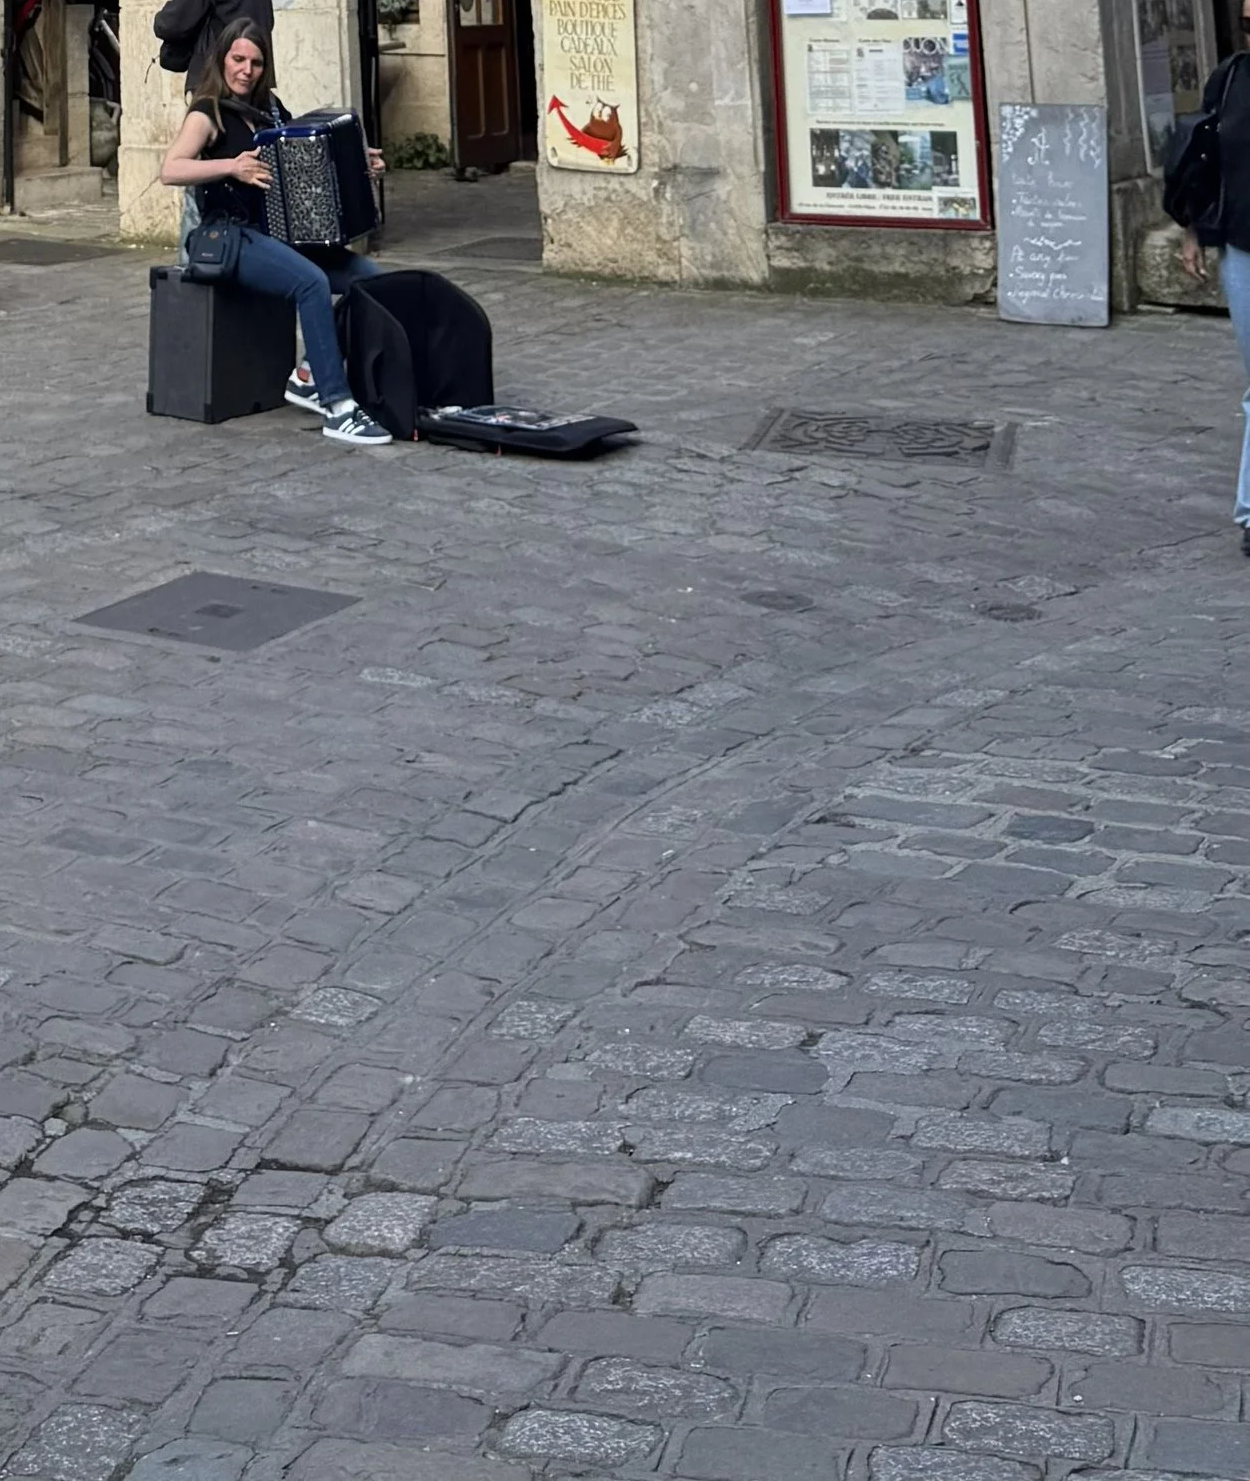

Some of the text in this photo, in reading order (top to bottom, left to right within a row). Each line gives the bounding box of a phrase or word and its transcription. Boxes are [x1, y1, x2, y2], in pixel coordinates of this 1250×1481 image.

[549, 0, 576, 17] PAIN
[557, 18, 617, 38] BOUTIQUE
[560, 36, 618, 58] CADEAUX
[569, 55, 614, 73] SALON
[570, 72, 588, 90] DE
